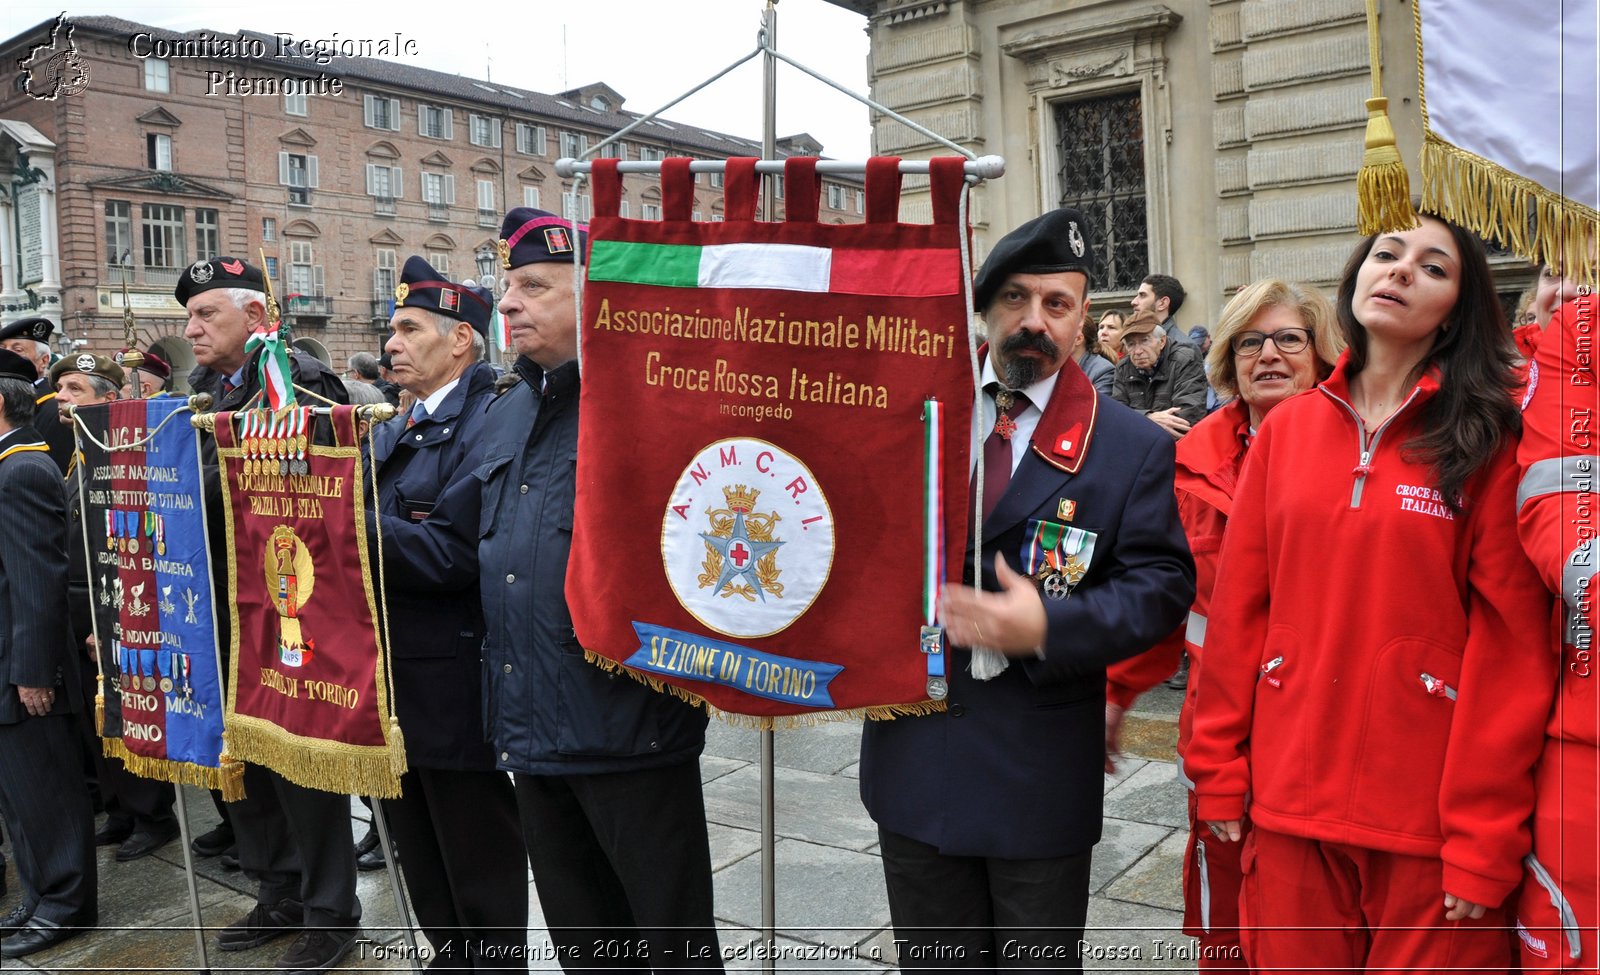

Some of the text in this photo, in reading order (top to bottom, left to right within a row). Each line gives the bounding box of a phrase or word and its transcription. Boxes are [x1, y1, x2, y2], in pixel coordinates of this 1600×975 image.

[594, 298, 955, 358] Associazione Nazionale Militari
[646, 351, 889, 409] Croce Rossa Italiana
[128, 465, 179, 482] NAZIONALE
[1396, 484, 1430, 499] CROCE
[281, 497, 293, 518] DI
[297, 497, 324, 519] STAT
[1401, 497, 1454, 520] ITALIANA
[142, 557, 193, 577] BANDIERA
[647, 635, 816, 699] SEZIONE DI TORINO
[304, 679, 359, 710] TORINO
